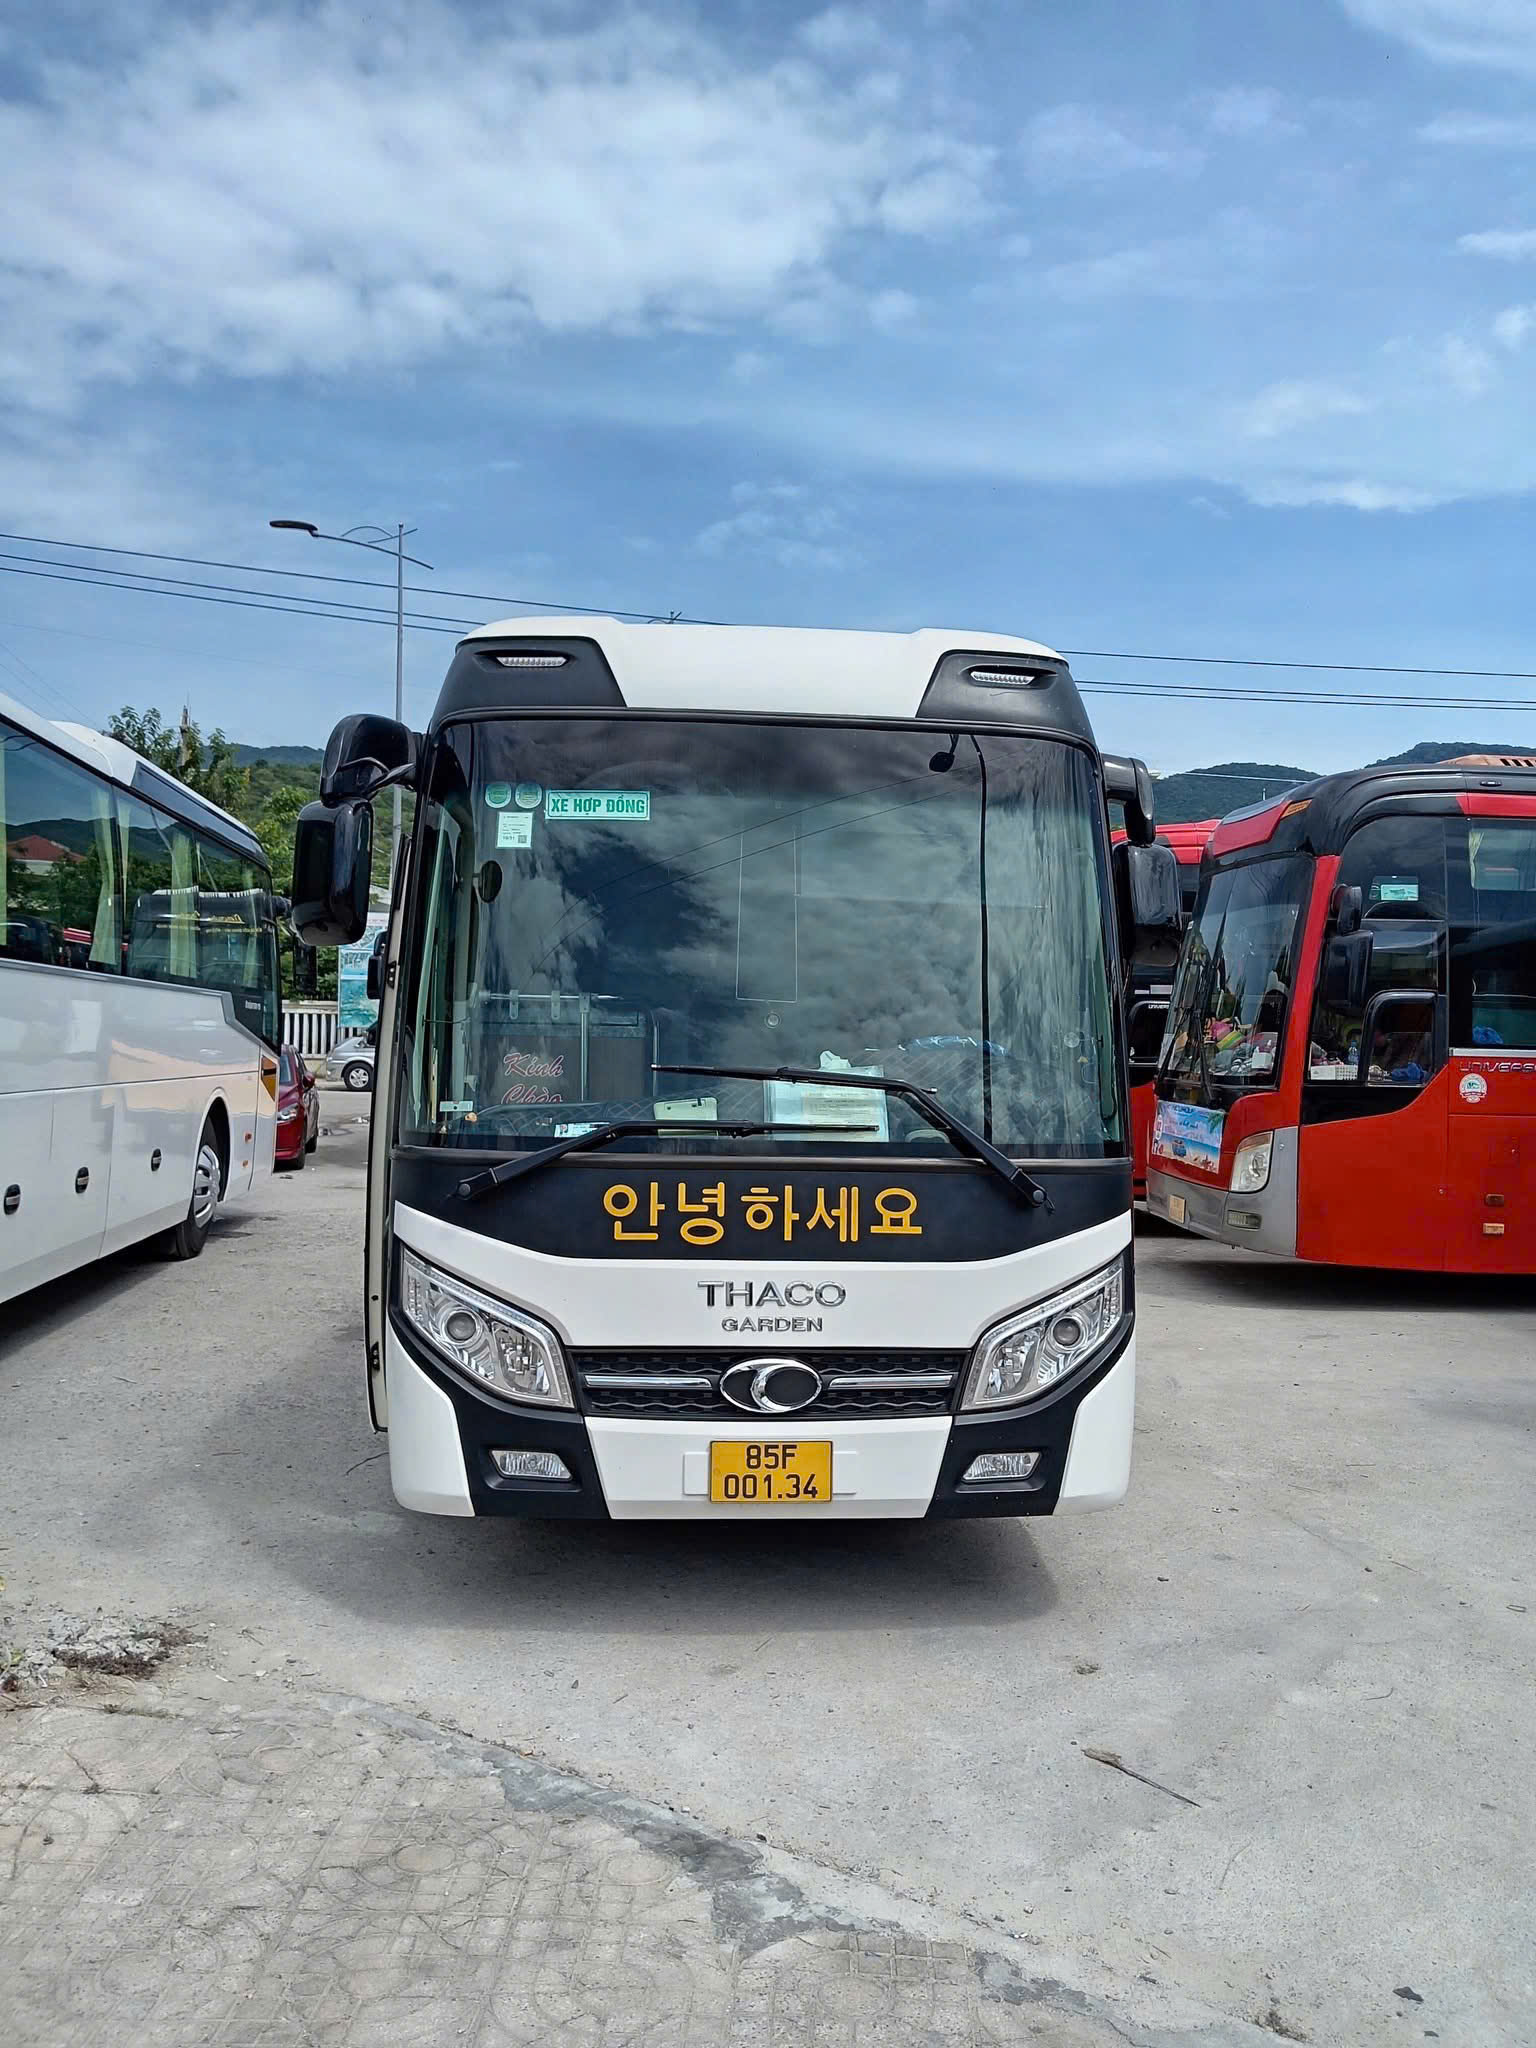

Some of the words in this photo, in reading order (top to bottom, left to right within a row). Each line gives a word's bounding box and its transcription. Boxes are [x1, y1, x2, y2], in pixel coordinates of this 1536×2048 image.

[574, 797, 602, 815] HỢP
[1459, 1061, 1536, 1073] UNIVERS
[603, 1182, 923, 1246] 안녕하세요
[697, 1280, 847, 1307] THACO
[721, 1316, 823, 1332] GARDEN
[745, 1443, 798, 1470] 85F
[723, 1473, 818, 1499] 001.34
